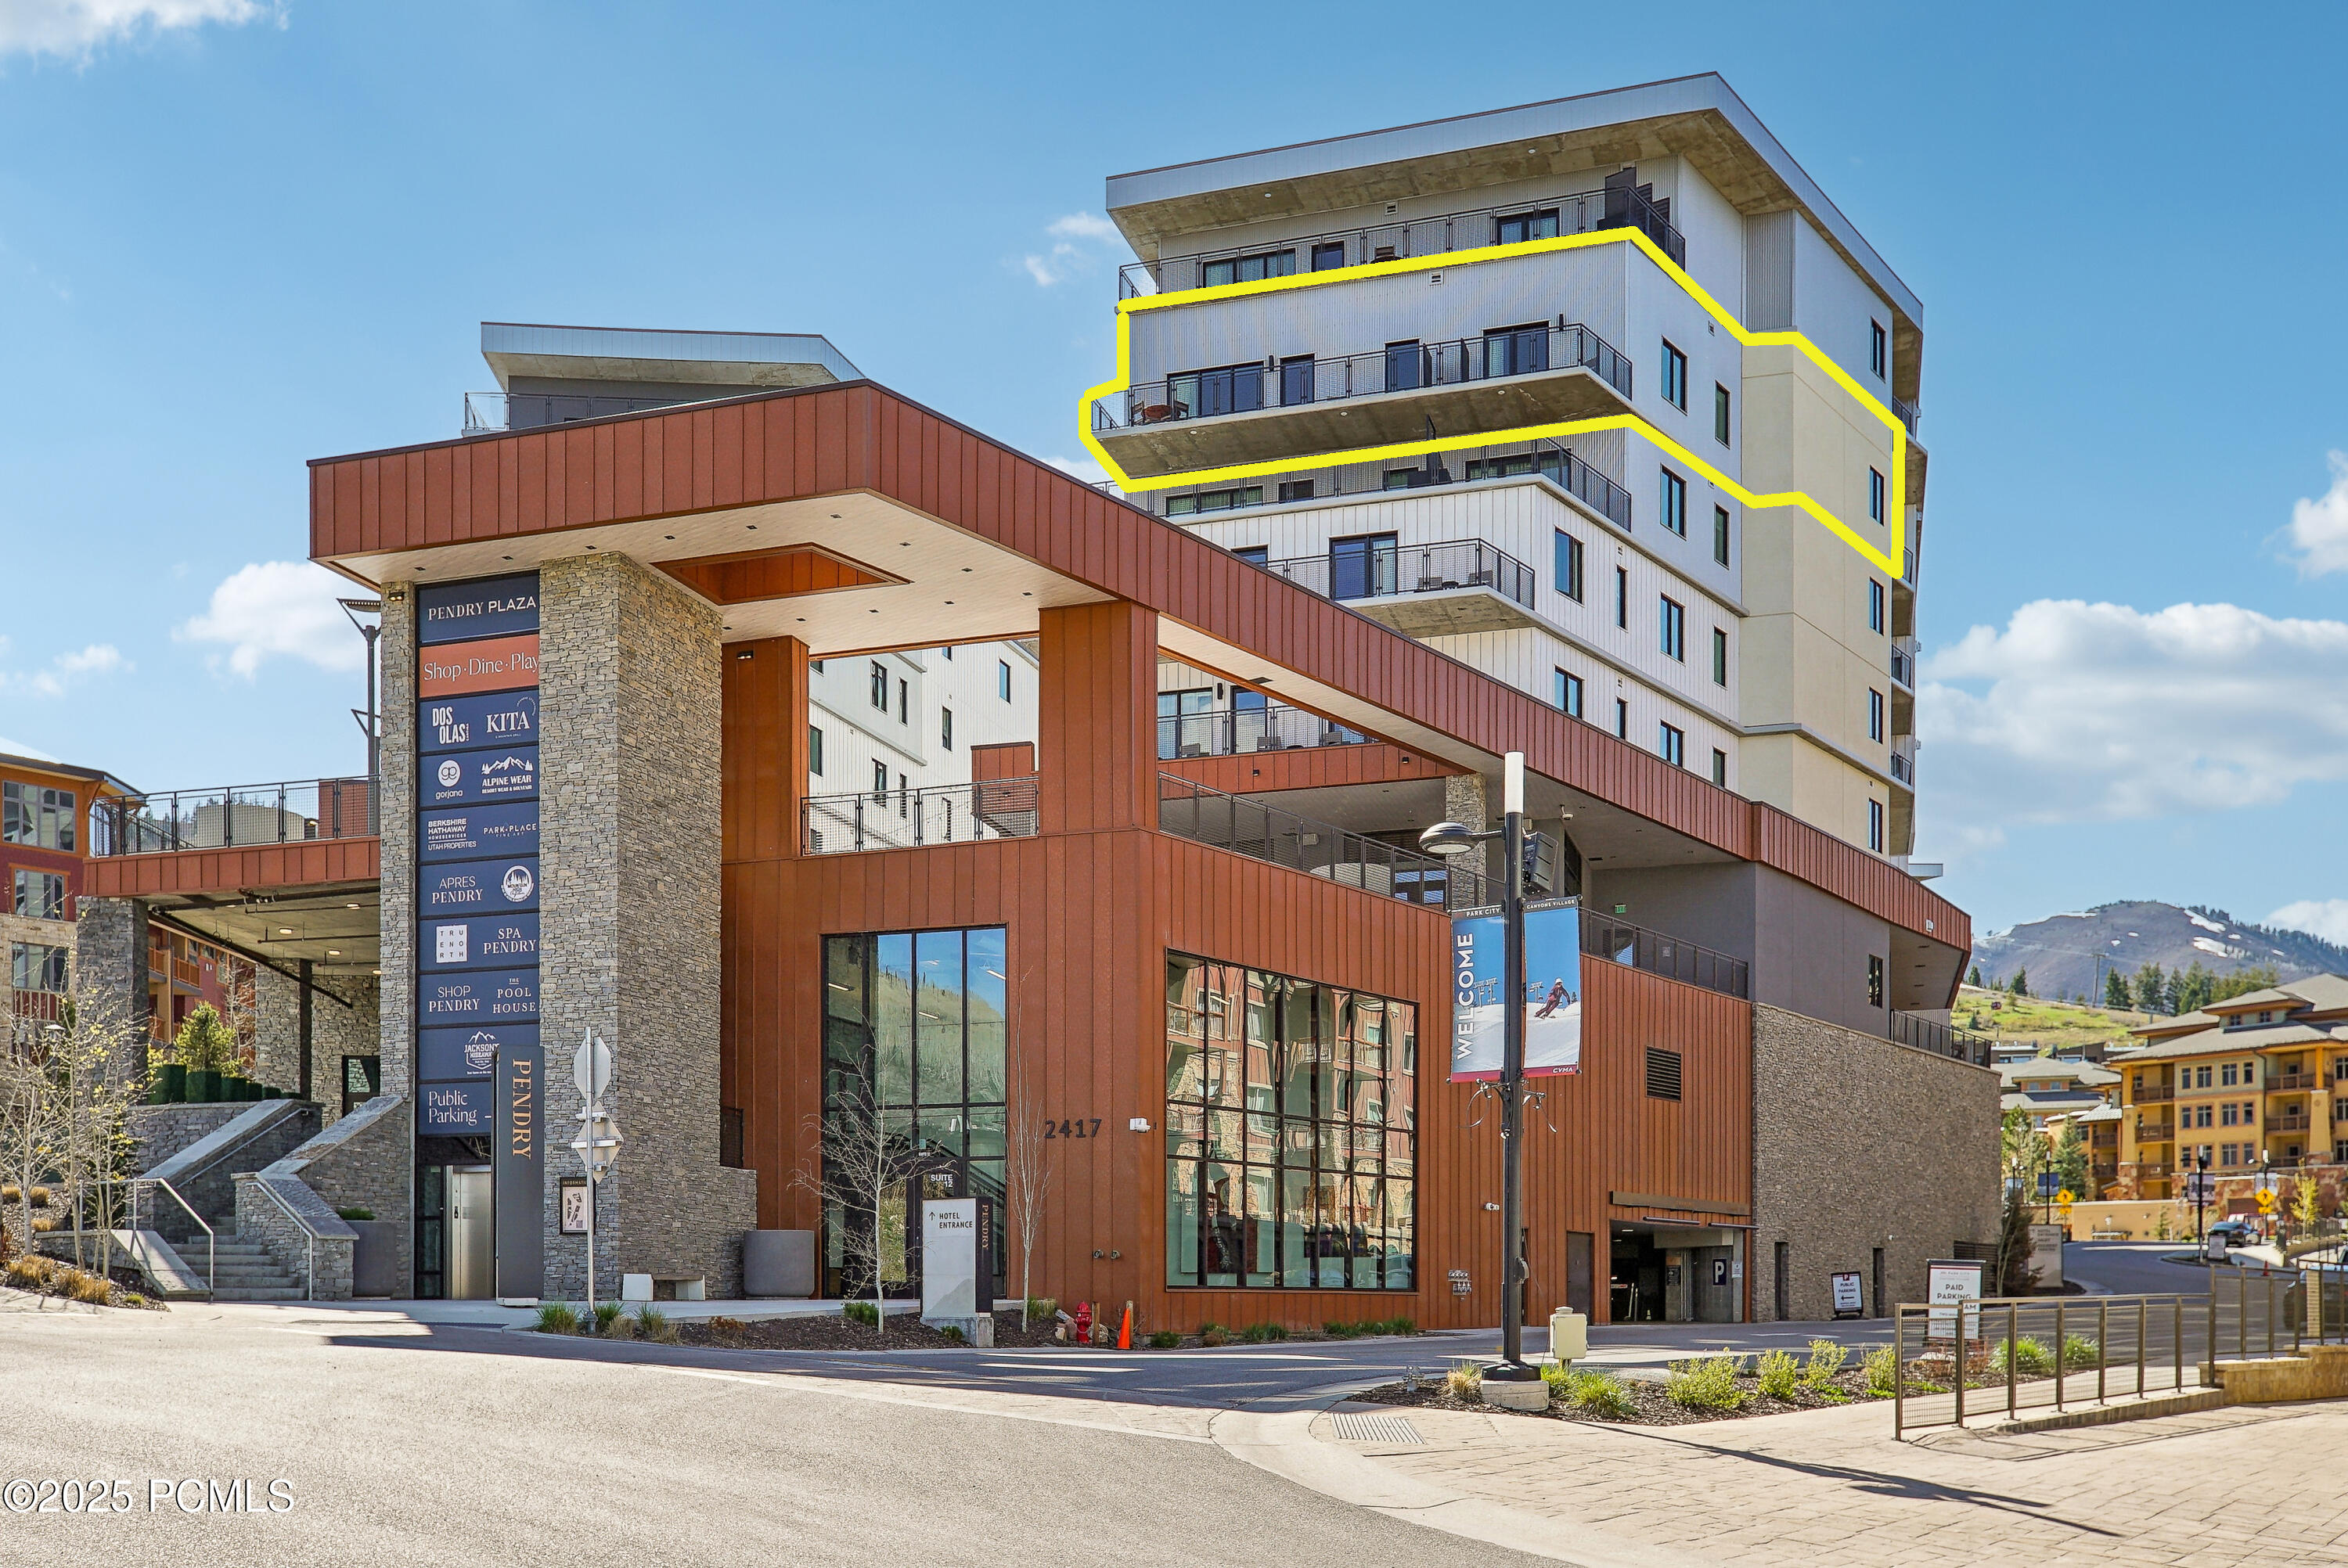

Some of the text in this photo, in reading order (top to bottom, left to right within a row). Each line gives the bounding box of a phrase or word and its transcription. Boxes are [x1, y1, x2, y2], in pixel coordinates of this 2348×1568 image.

[428, 596, 536, 620] PENDRY PLAZA
[423, 652, 538, 682] Shop Dine Play
[432, 707, 452, 726] DOS
[486, 710, 530, 733] KITA
[439, 723, 466, 744] OLAS
[482, 775, 531, 786] ALPINE WEAR
[435, 789, 463, 800] gorjana
[428, 818, 466, 828] BERKSHIRE
[428, 825, 466, 834] HATHAWAY
[444, 840, 477, 849] PROPERTIES
[439, 876, 476, 889] APRES
[432, 889, 483, 904] PENDRY
[498, 928, 521, 939] SPA
[483, 940, 536, 954] PENDRY
[438, 985, 470, 998] SHOP
[497, 987, 531, 998] POOL
[1457, 933, 1475, 1060] WELCOME
[428, 998, 480, 1012] PENDRY
[492, 1002, 536, 1013] HOUSE
[429, 1090, 468, 1106] Public
[429, 1107, 477, 1126] Parking
[513, 1059, 531, 1160] PENDRY
[1044, 1118, 1102, 1138] 2417
[1715, 1261, 1724, 1283] P
